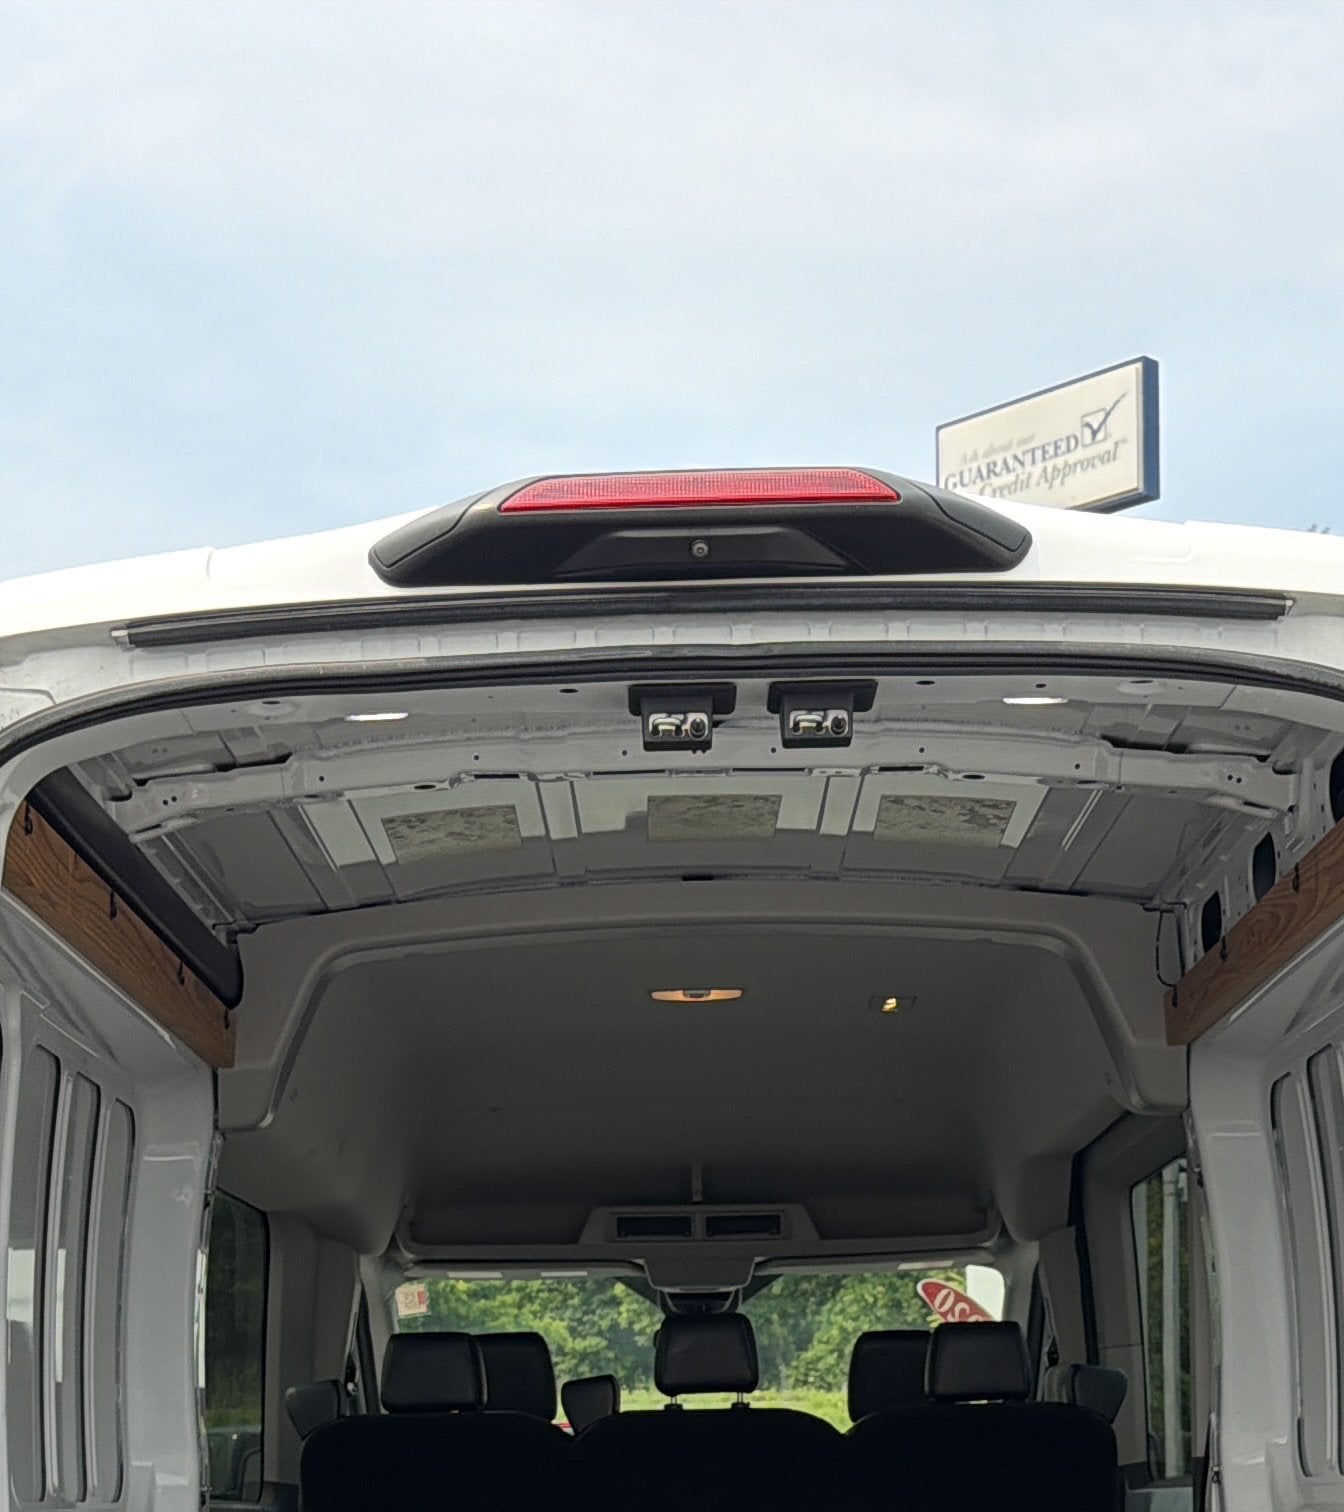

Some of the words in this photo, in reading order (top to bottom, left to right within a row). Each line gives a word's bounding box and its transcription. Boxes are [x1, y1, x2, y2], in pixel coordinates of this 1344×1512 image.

[944, 433, 1080, 491] GUARANTEED
[978, 470, 1034, 499] Credit
[1036, 441, 1119, 489] Approval
